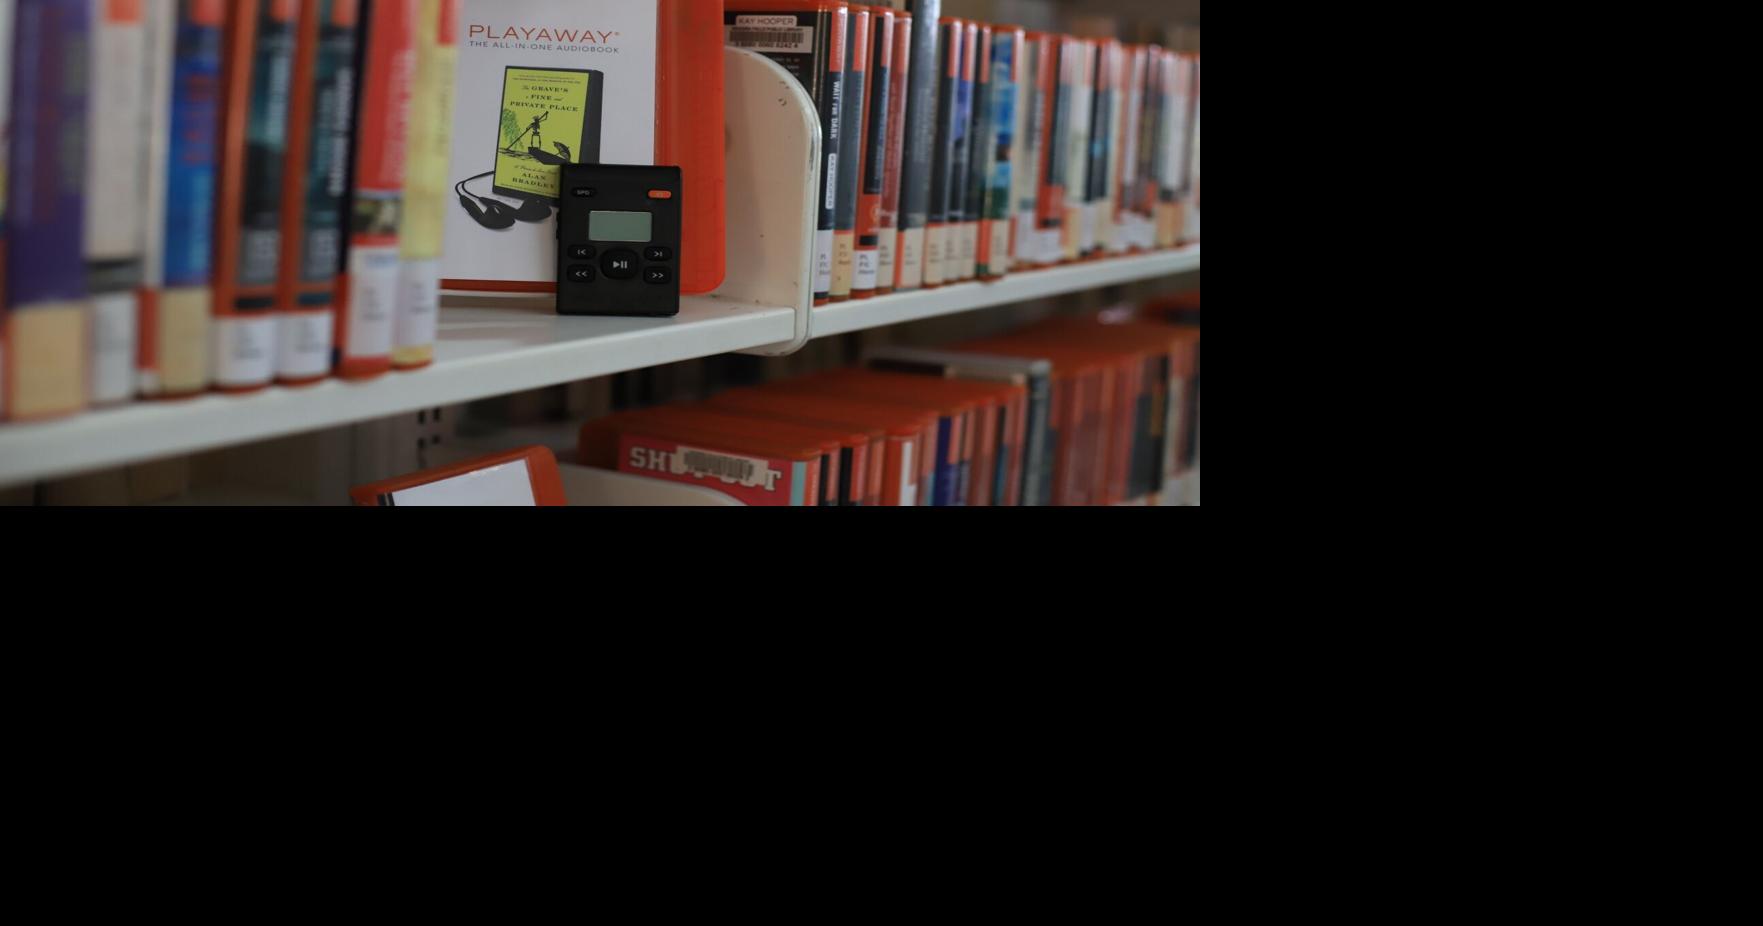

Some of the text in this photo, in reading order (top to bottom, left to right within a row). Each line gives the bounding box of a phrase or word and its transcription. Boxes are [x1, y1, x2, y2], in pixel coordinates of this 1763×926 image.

[738, 17, 794, 25] KAY HOOPER
[469, 40, 620, 54] THE ALL-IN-ONE AUDIOBOOK
[832, 80, 841, 100] WAIT
[510, 101, 578, 112] PRIVATE PLACE
[830, 118, 839, 139] DARK
[521, 172, 546, 181] ALAN
